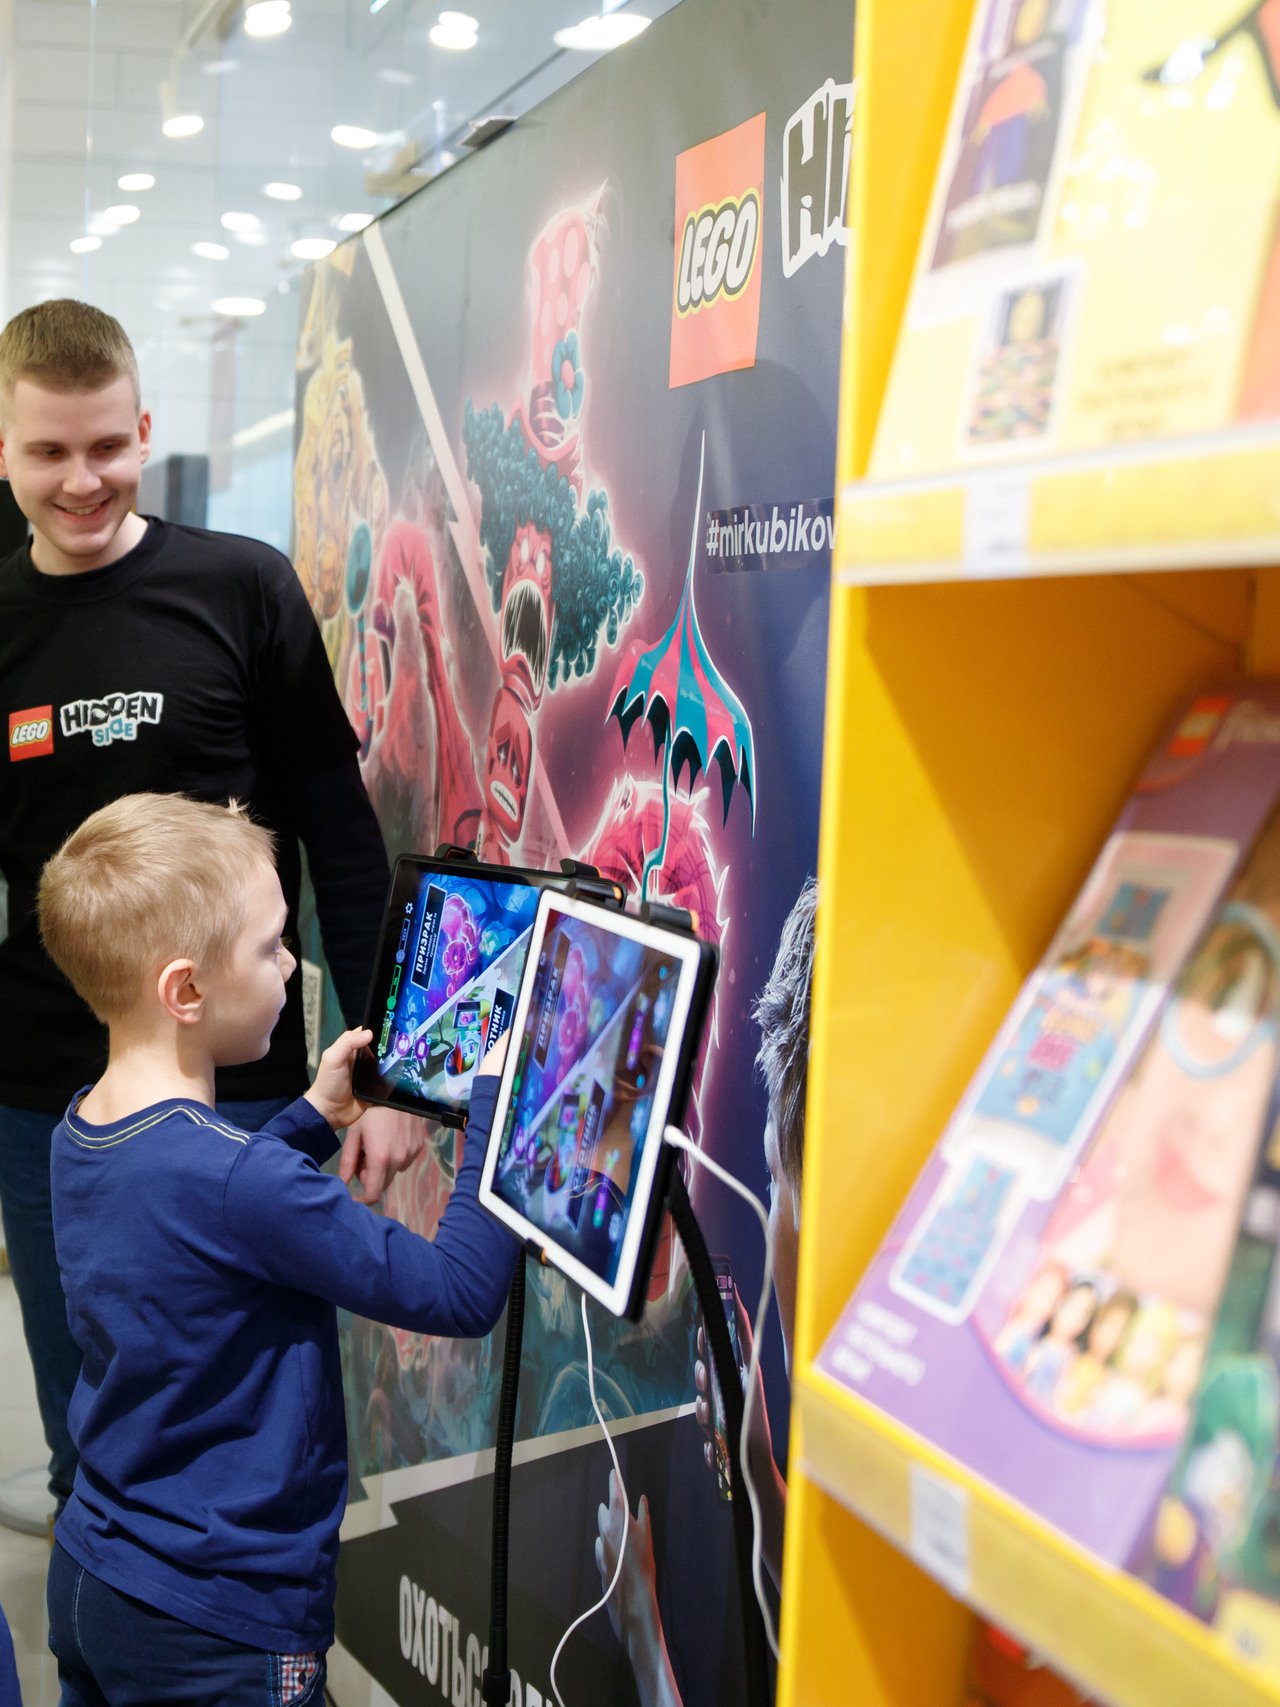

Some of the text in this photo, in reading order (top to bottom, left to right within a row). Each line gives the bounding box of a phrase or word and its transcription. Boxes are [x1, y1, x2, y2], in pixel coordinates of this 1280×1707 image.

[781, 84, 854, 274] HI
[677, 196, 759, 310] LEGO
[11, 693, 160, 746] LEGO HIDDEN
[94, 717, 134, 744] SIDE
[416, 911, 433, 973] ПРИЗРАК
[487, 1004, 502, 1051] ОТНИК
[399, 1574, 489, 1707] ОХОТЬС
